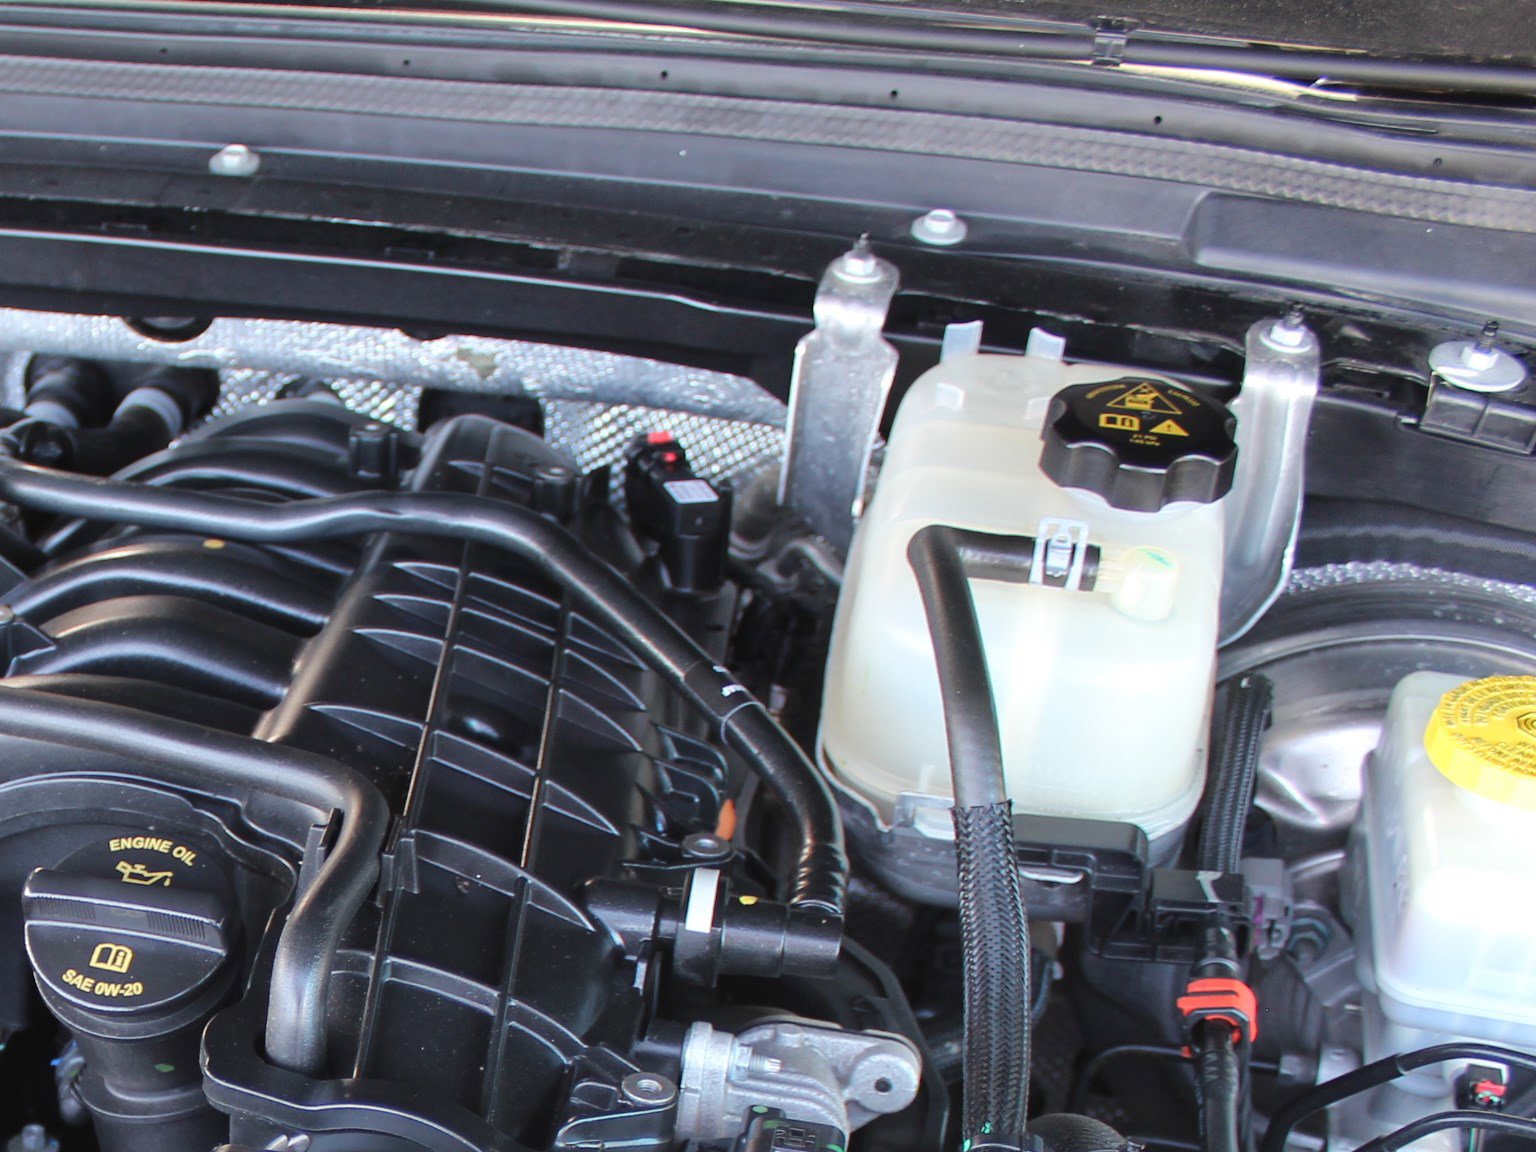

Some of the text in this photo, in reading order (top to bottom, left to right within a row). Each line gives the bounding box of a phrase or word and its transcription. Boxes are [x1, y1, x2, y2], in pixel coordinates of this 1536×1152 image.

[109, 836, 197, 866] ENGINE OIL
[61, 969, 144, 997] SAE 0W-20
